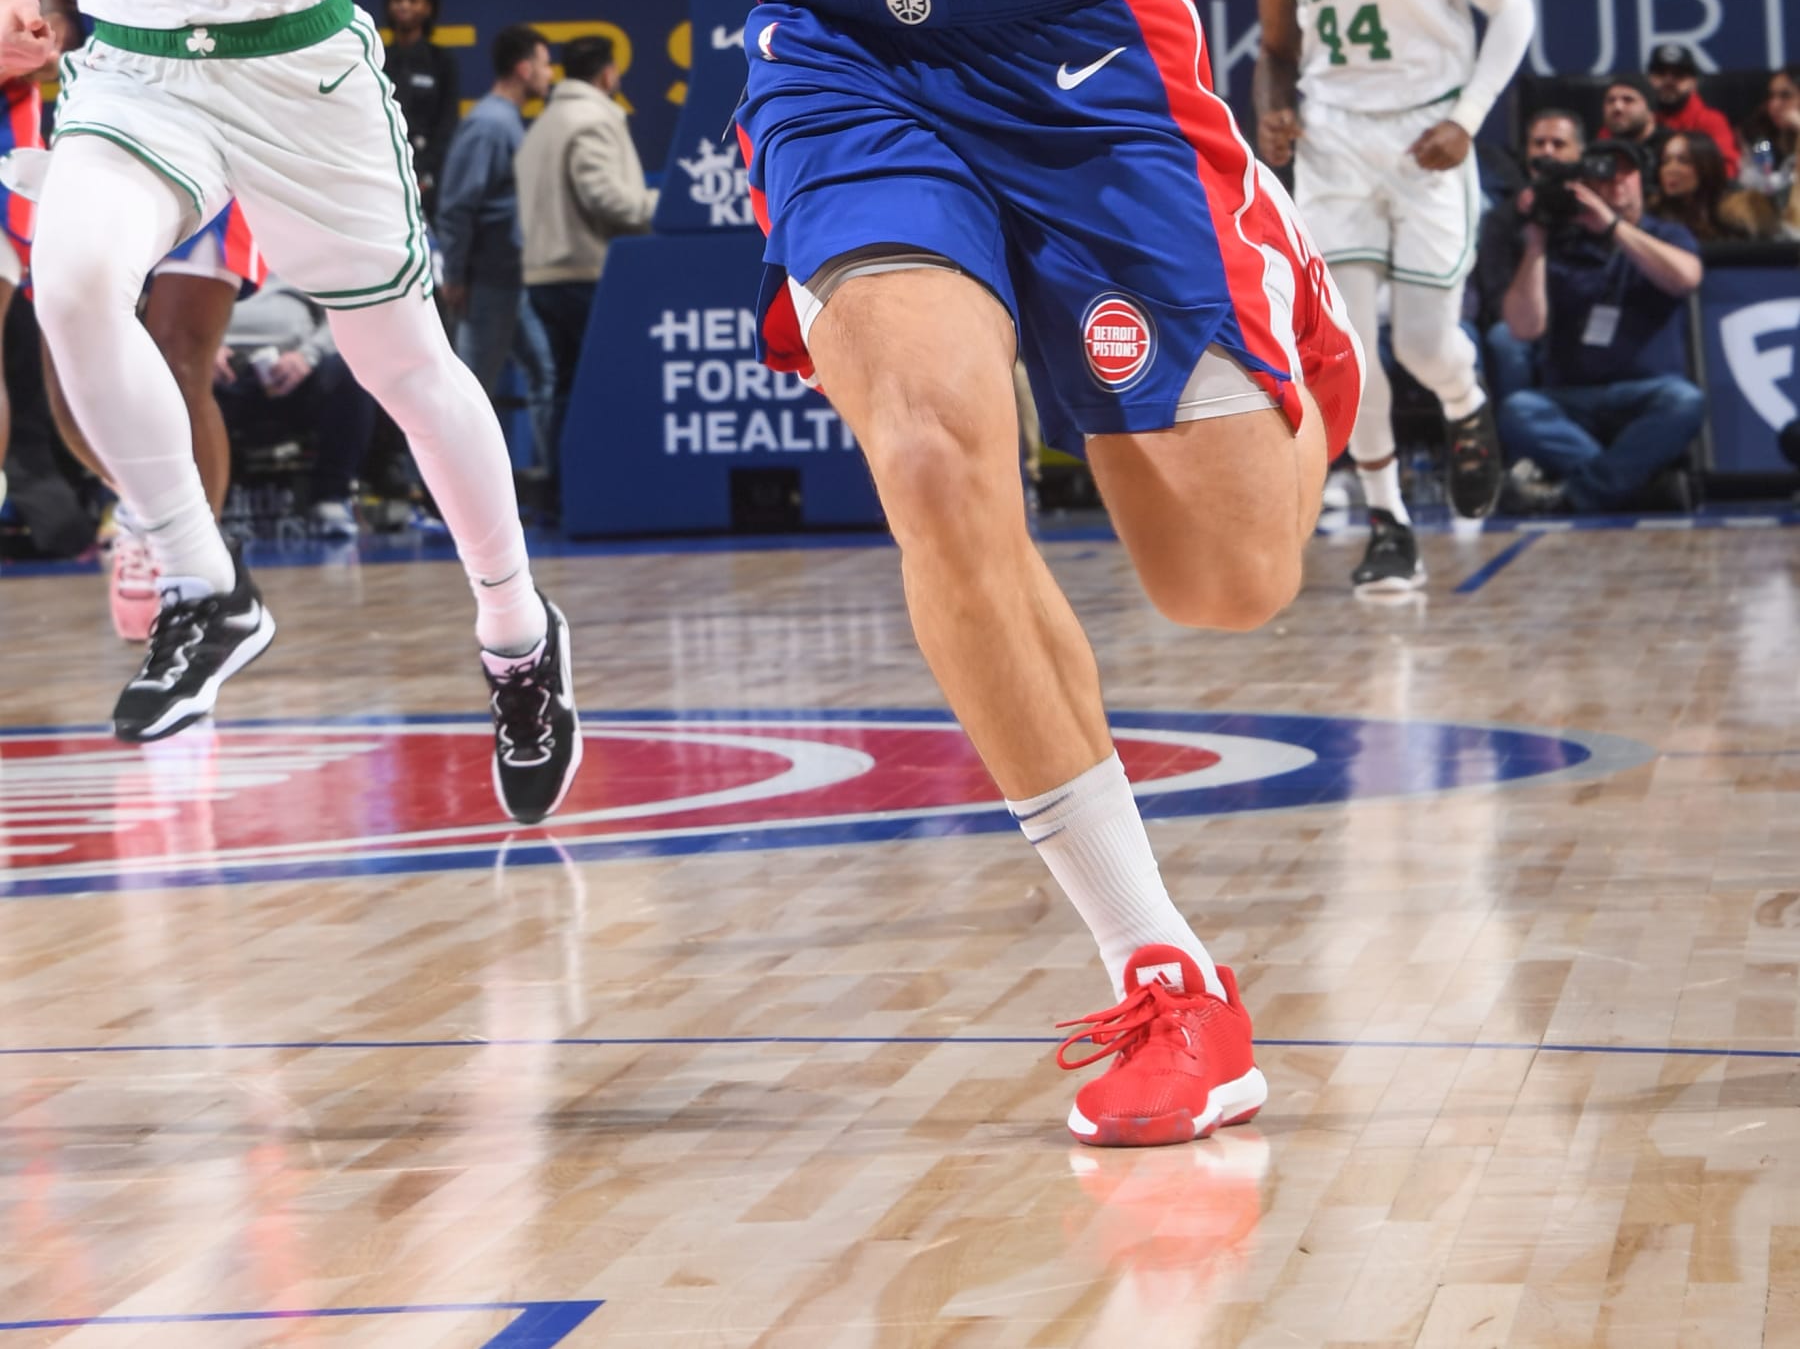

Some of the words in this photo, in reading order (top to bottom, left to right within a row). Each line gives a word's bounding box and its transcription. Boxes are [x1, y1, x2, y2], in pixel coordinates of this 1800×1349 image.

[1317, 3, 1393, 66] 44
[1092, 325, 1139, 341] DETROIT
[1092, 341, 1139, 358] PISTONS
